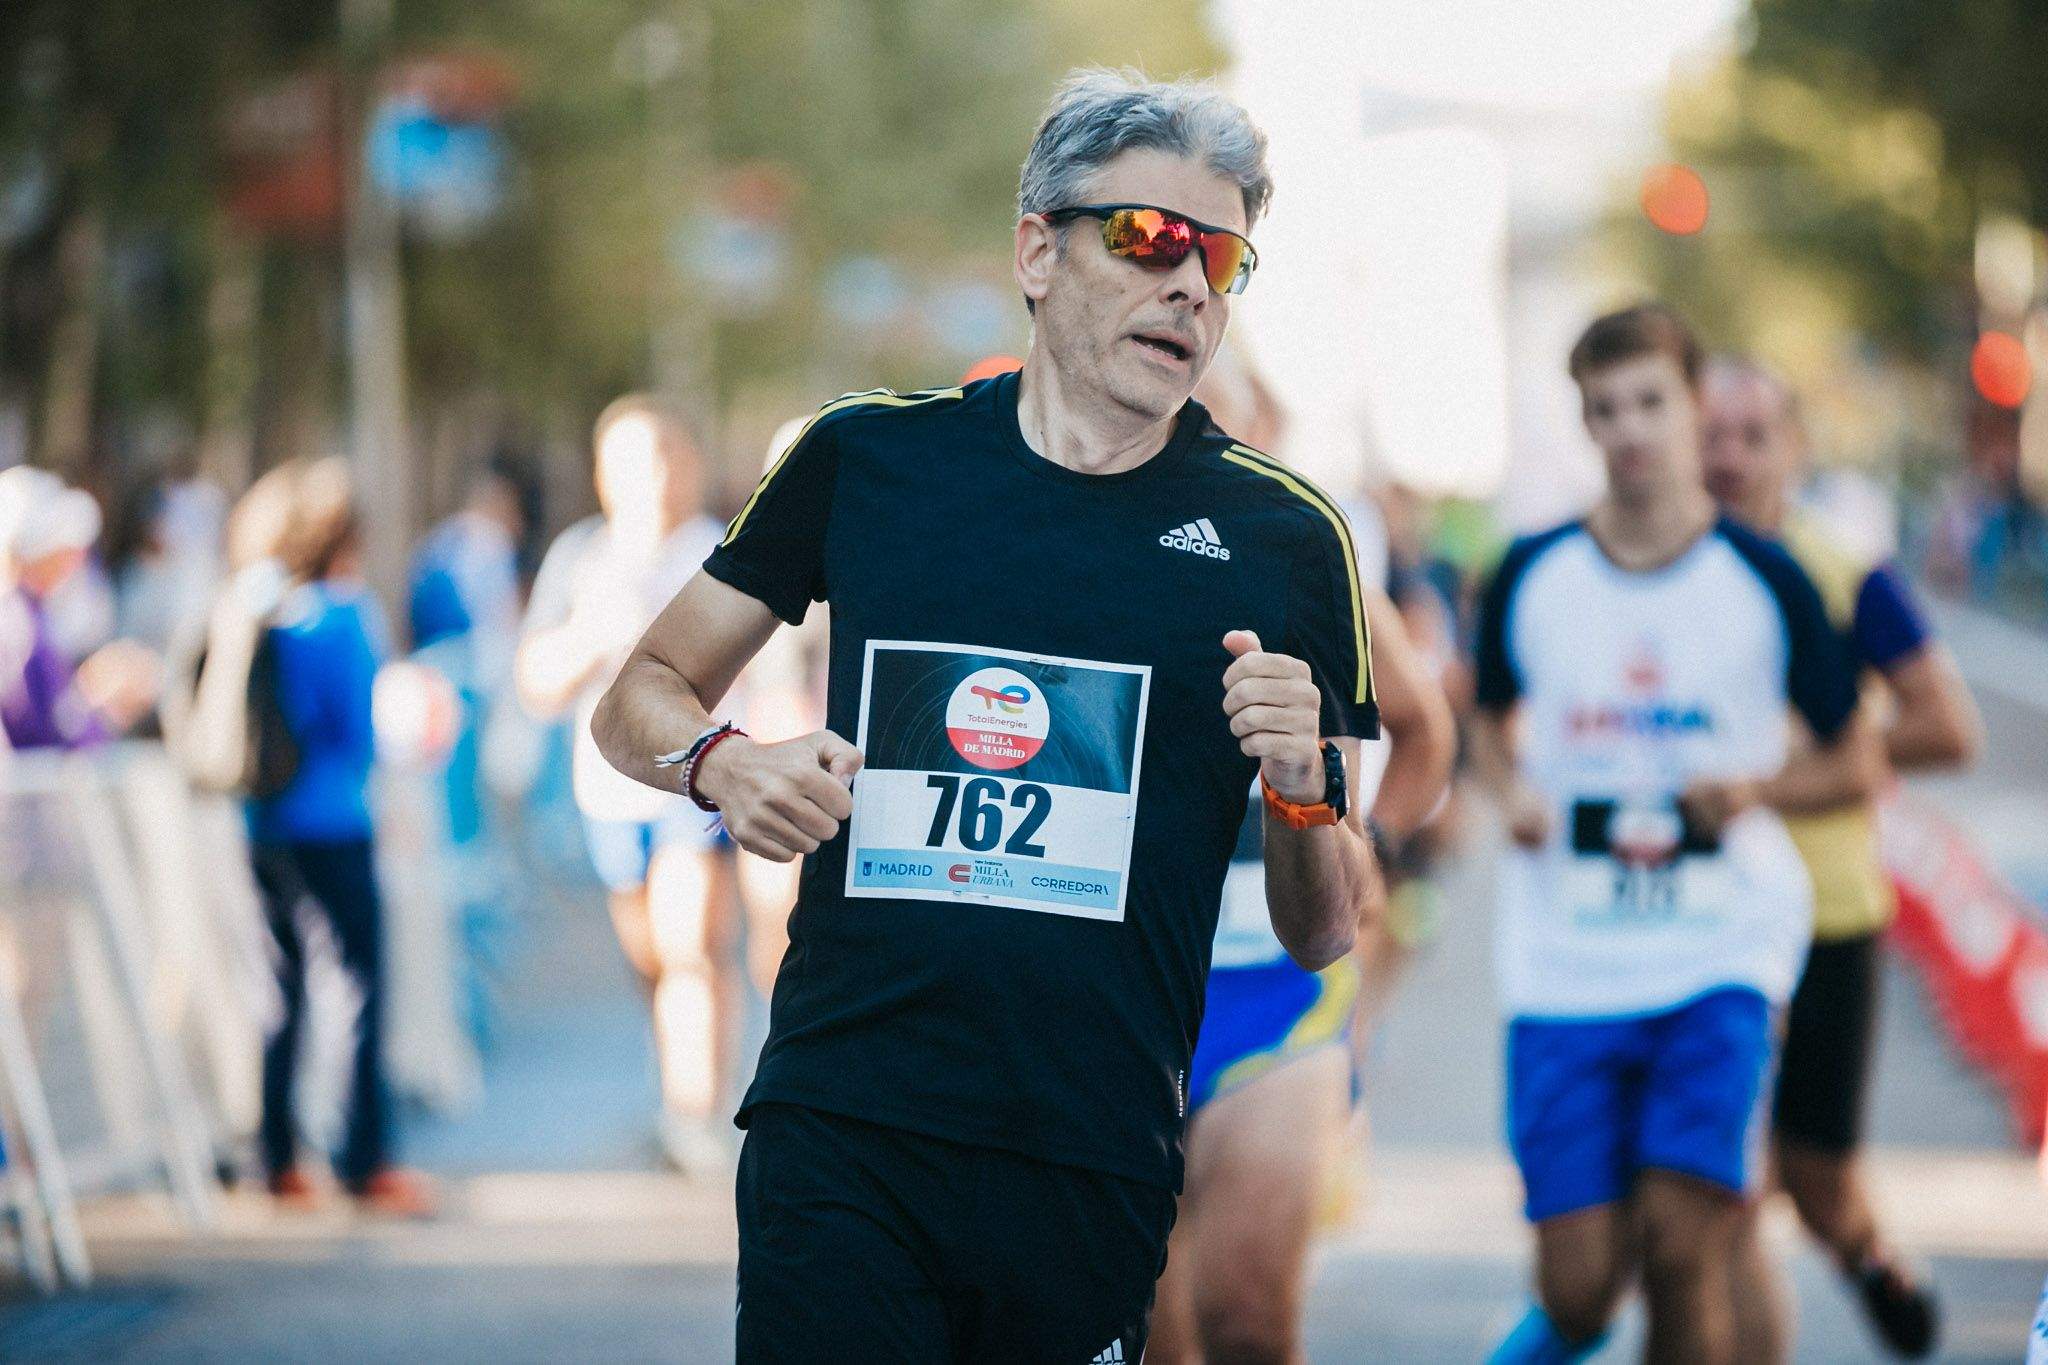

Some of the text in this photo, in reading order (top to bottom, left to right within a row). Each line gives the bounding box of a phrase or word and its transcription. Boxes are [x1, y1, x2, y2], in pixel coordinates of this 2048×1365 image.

[1159, 535, 1230, 561] adidas
[968, 714, 1028, 729] TotalEnergies
[979, 734, 1013, 746] MILLA
[964, 743, 1026, 759] DE MADRID
[925, 774, 1052, 859] 762
[879, 863, 933, 877] MADRID
[975, 866, 1009, 878] MILLA
[972, 876, 1014, 888] URBANA
